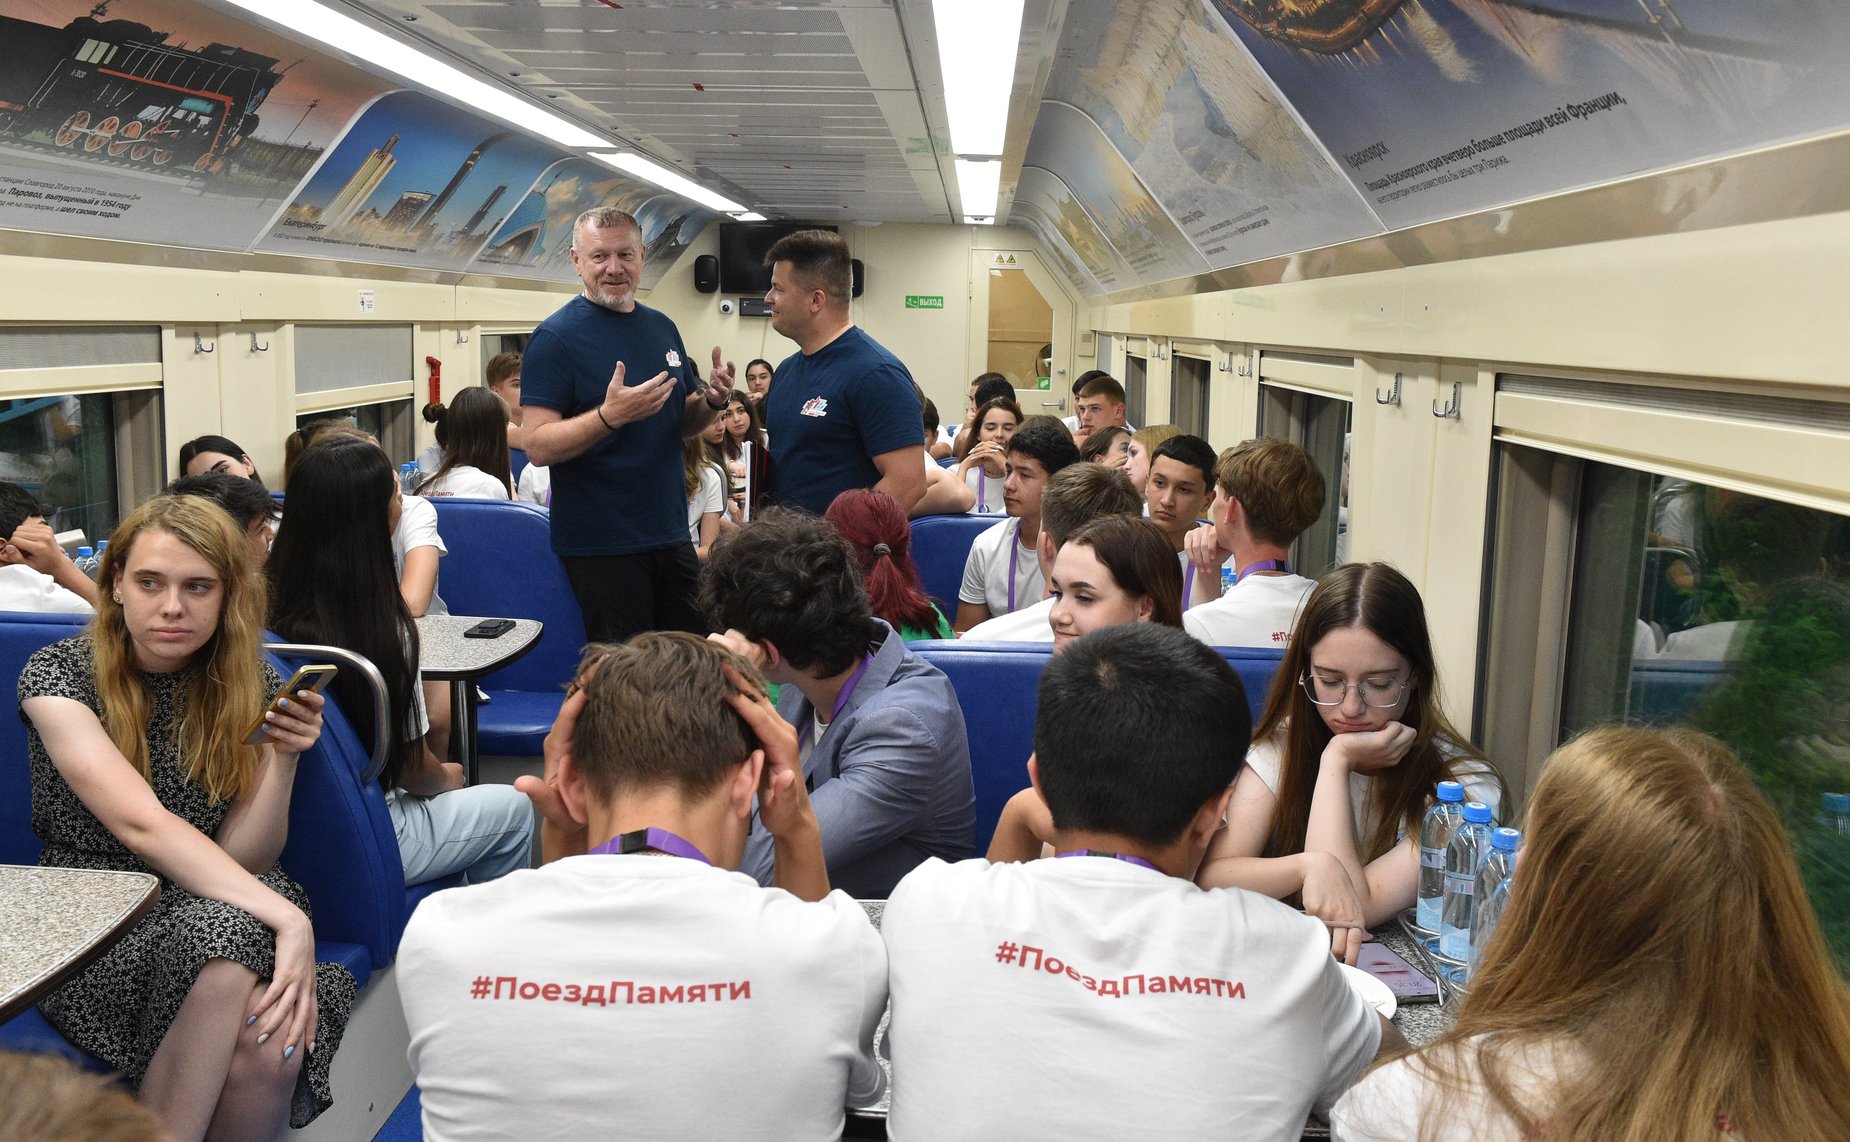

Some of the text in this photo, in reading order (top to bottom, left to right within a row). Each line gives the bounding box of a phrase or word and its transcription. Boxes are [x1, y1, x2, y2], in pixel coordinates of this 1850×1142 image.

[1364, 91, 1627, 192] Площадь Красноярского края вчетверо больше площади всей Франции,
[1342, 140, 1390, 171] Красноярск
[8, 187, 42, 200] Паровоз,
[45, 193, 94, 206] выпущенный
[100, 199, 117, 208] 1954
[116, 202, 132, 211] году
[60, 206, 76, 214] шел
[76, 208, 98, 216] своим
[283, 217, 327, 232] Екатеринбург
[919, 298, 942, 307] ВЫХОД
[996, 941, 1246, 1000] #ПоездПамяти
[470, 976, 751, 1007] #ПоездПамяти
